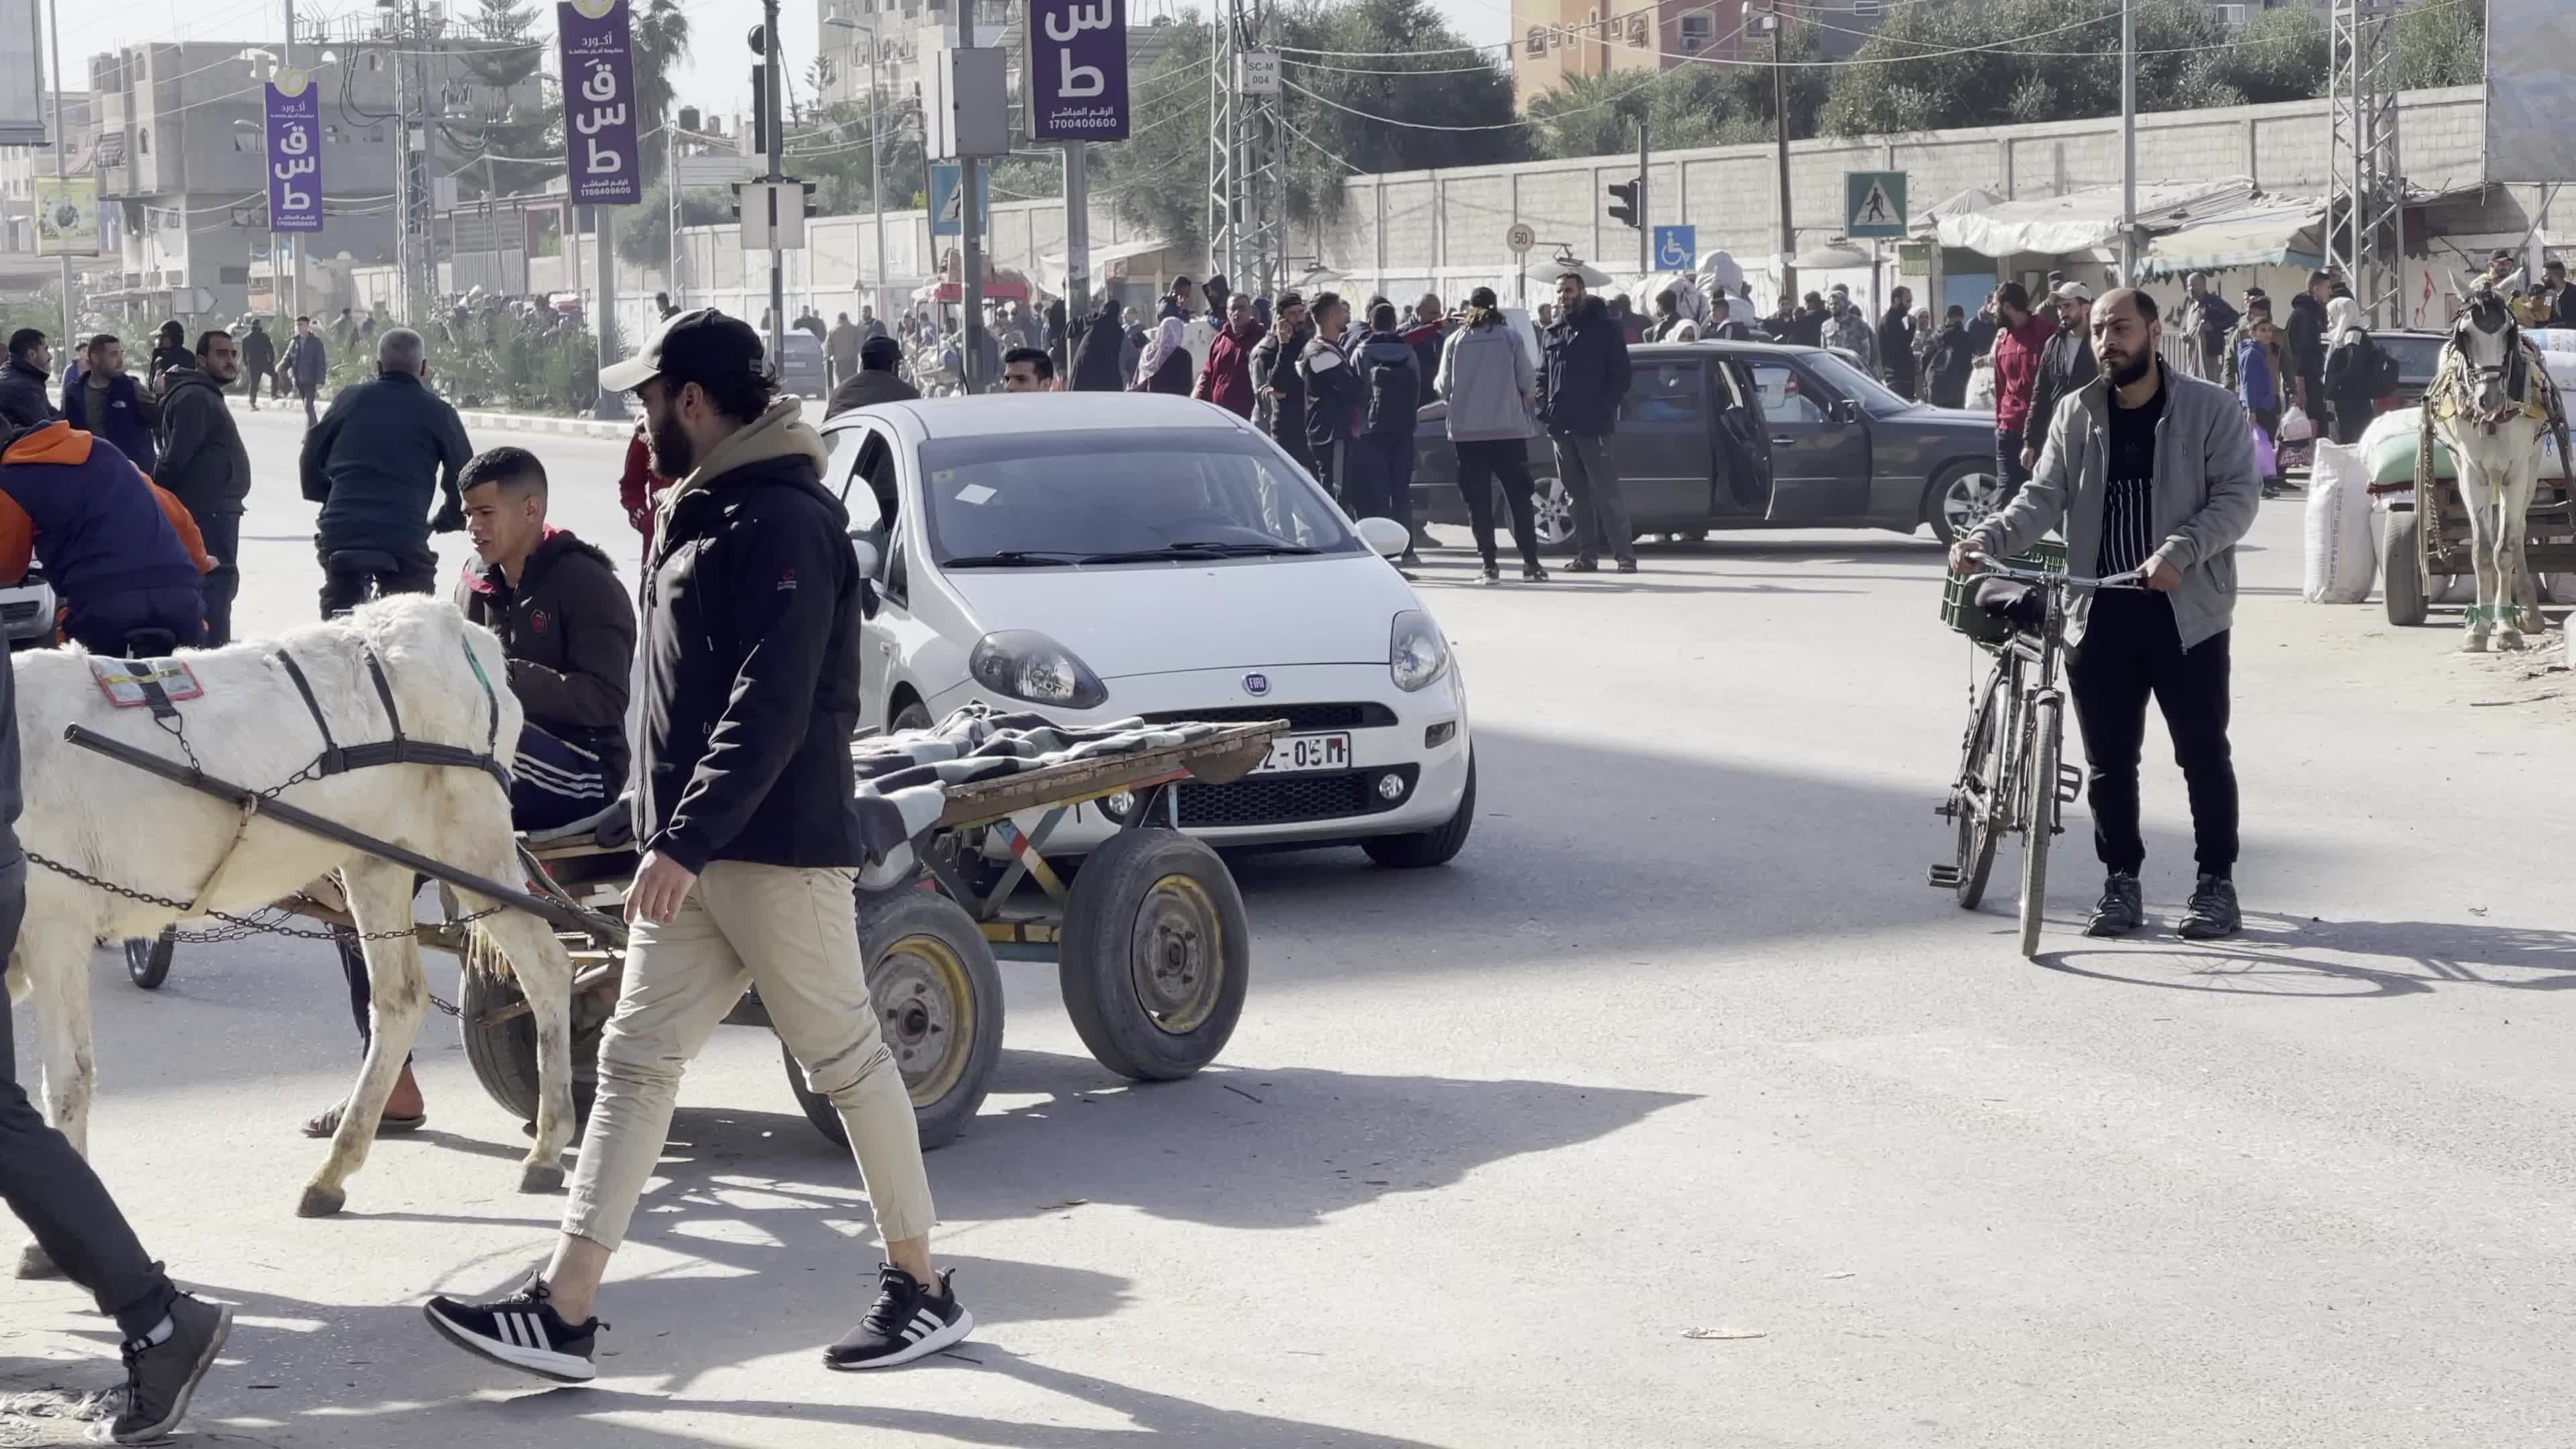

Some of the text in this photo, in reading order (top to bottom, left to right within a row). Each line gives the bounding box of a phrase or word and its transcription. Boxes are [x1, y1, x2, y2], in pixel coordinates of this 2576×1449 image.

[581, 30, 612, 48] أكورد
[1248, 62, 1274, 71] SC-M
[1252, 75, 1269, 85] 004
[1051, 107, 1114, 119] الرقم المباشر
[1049, 118, 1117, 129] 1700400600
[580, 186, 632, 197] 1700400600
[1515, 232, 1527, 244] 50
[1248, 677, 1265, 689] FIAT
